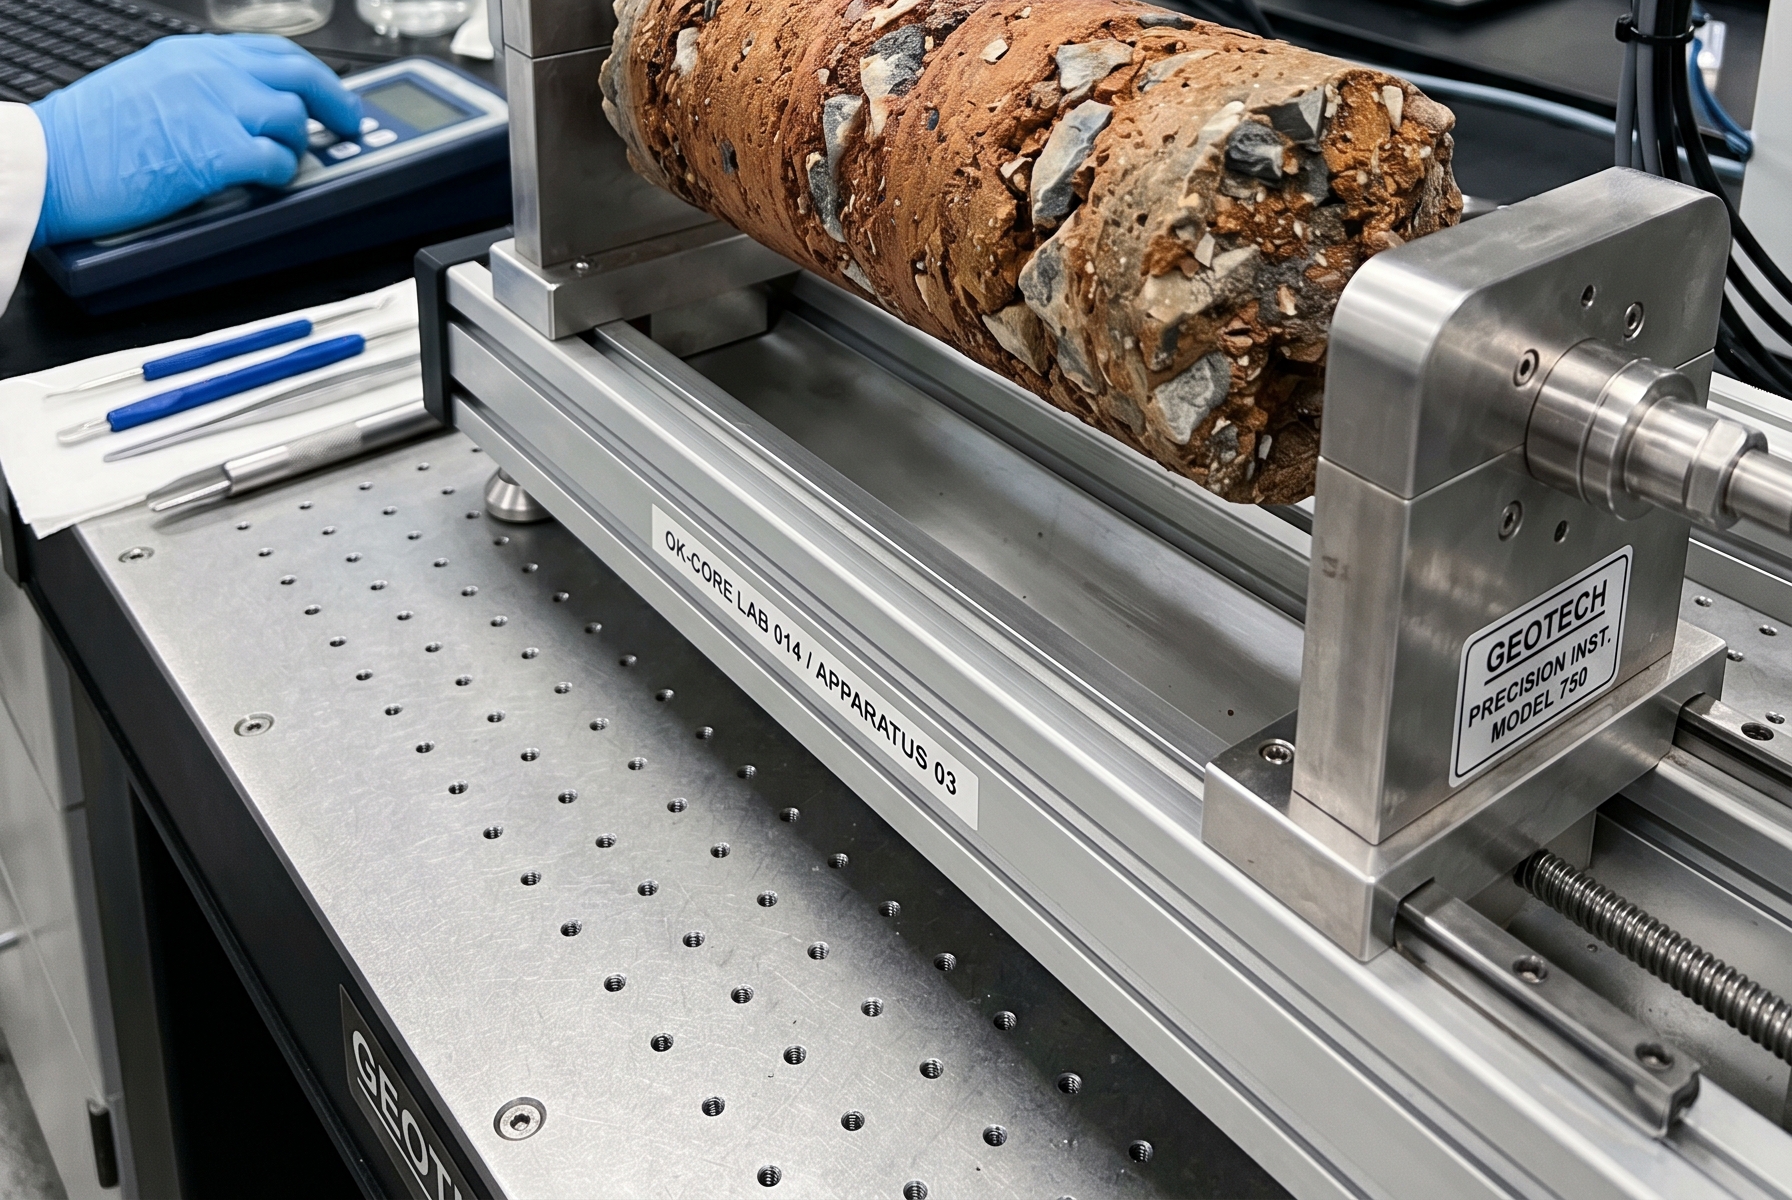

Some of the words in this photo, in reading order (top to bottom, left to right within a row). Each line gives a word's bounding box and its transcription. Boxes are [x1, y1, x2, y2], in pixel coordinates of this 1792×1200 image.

[665, 530, 734, 604] OK-CORE
[736, 590, 769, 634] LAB
[773, 623, 802, 662] 014
[815, 661, 928, 771] APPARATUS
[934, 761, 957, 796] 03
[1468, 652, 1566, 728] PRECISION
[1570, 625, 1611, 666] INST.
[1486, 579, 1608, 673] GEOTECH
[1491, 690, 1554, 743] MODEL
[1559, 666, 1588, 699] 750
[352, 1030, 462, 1200] GEOT
